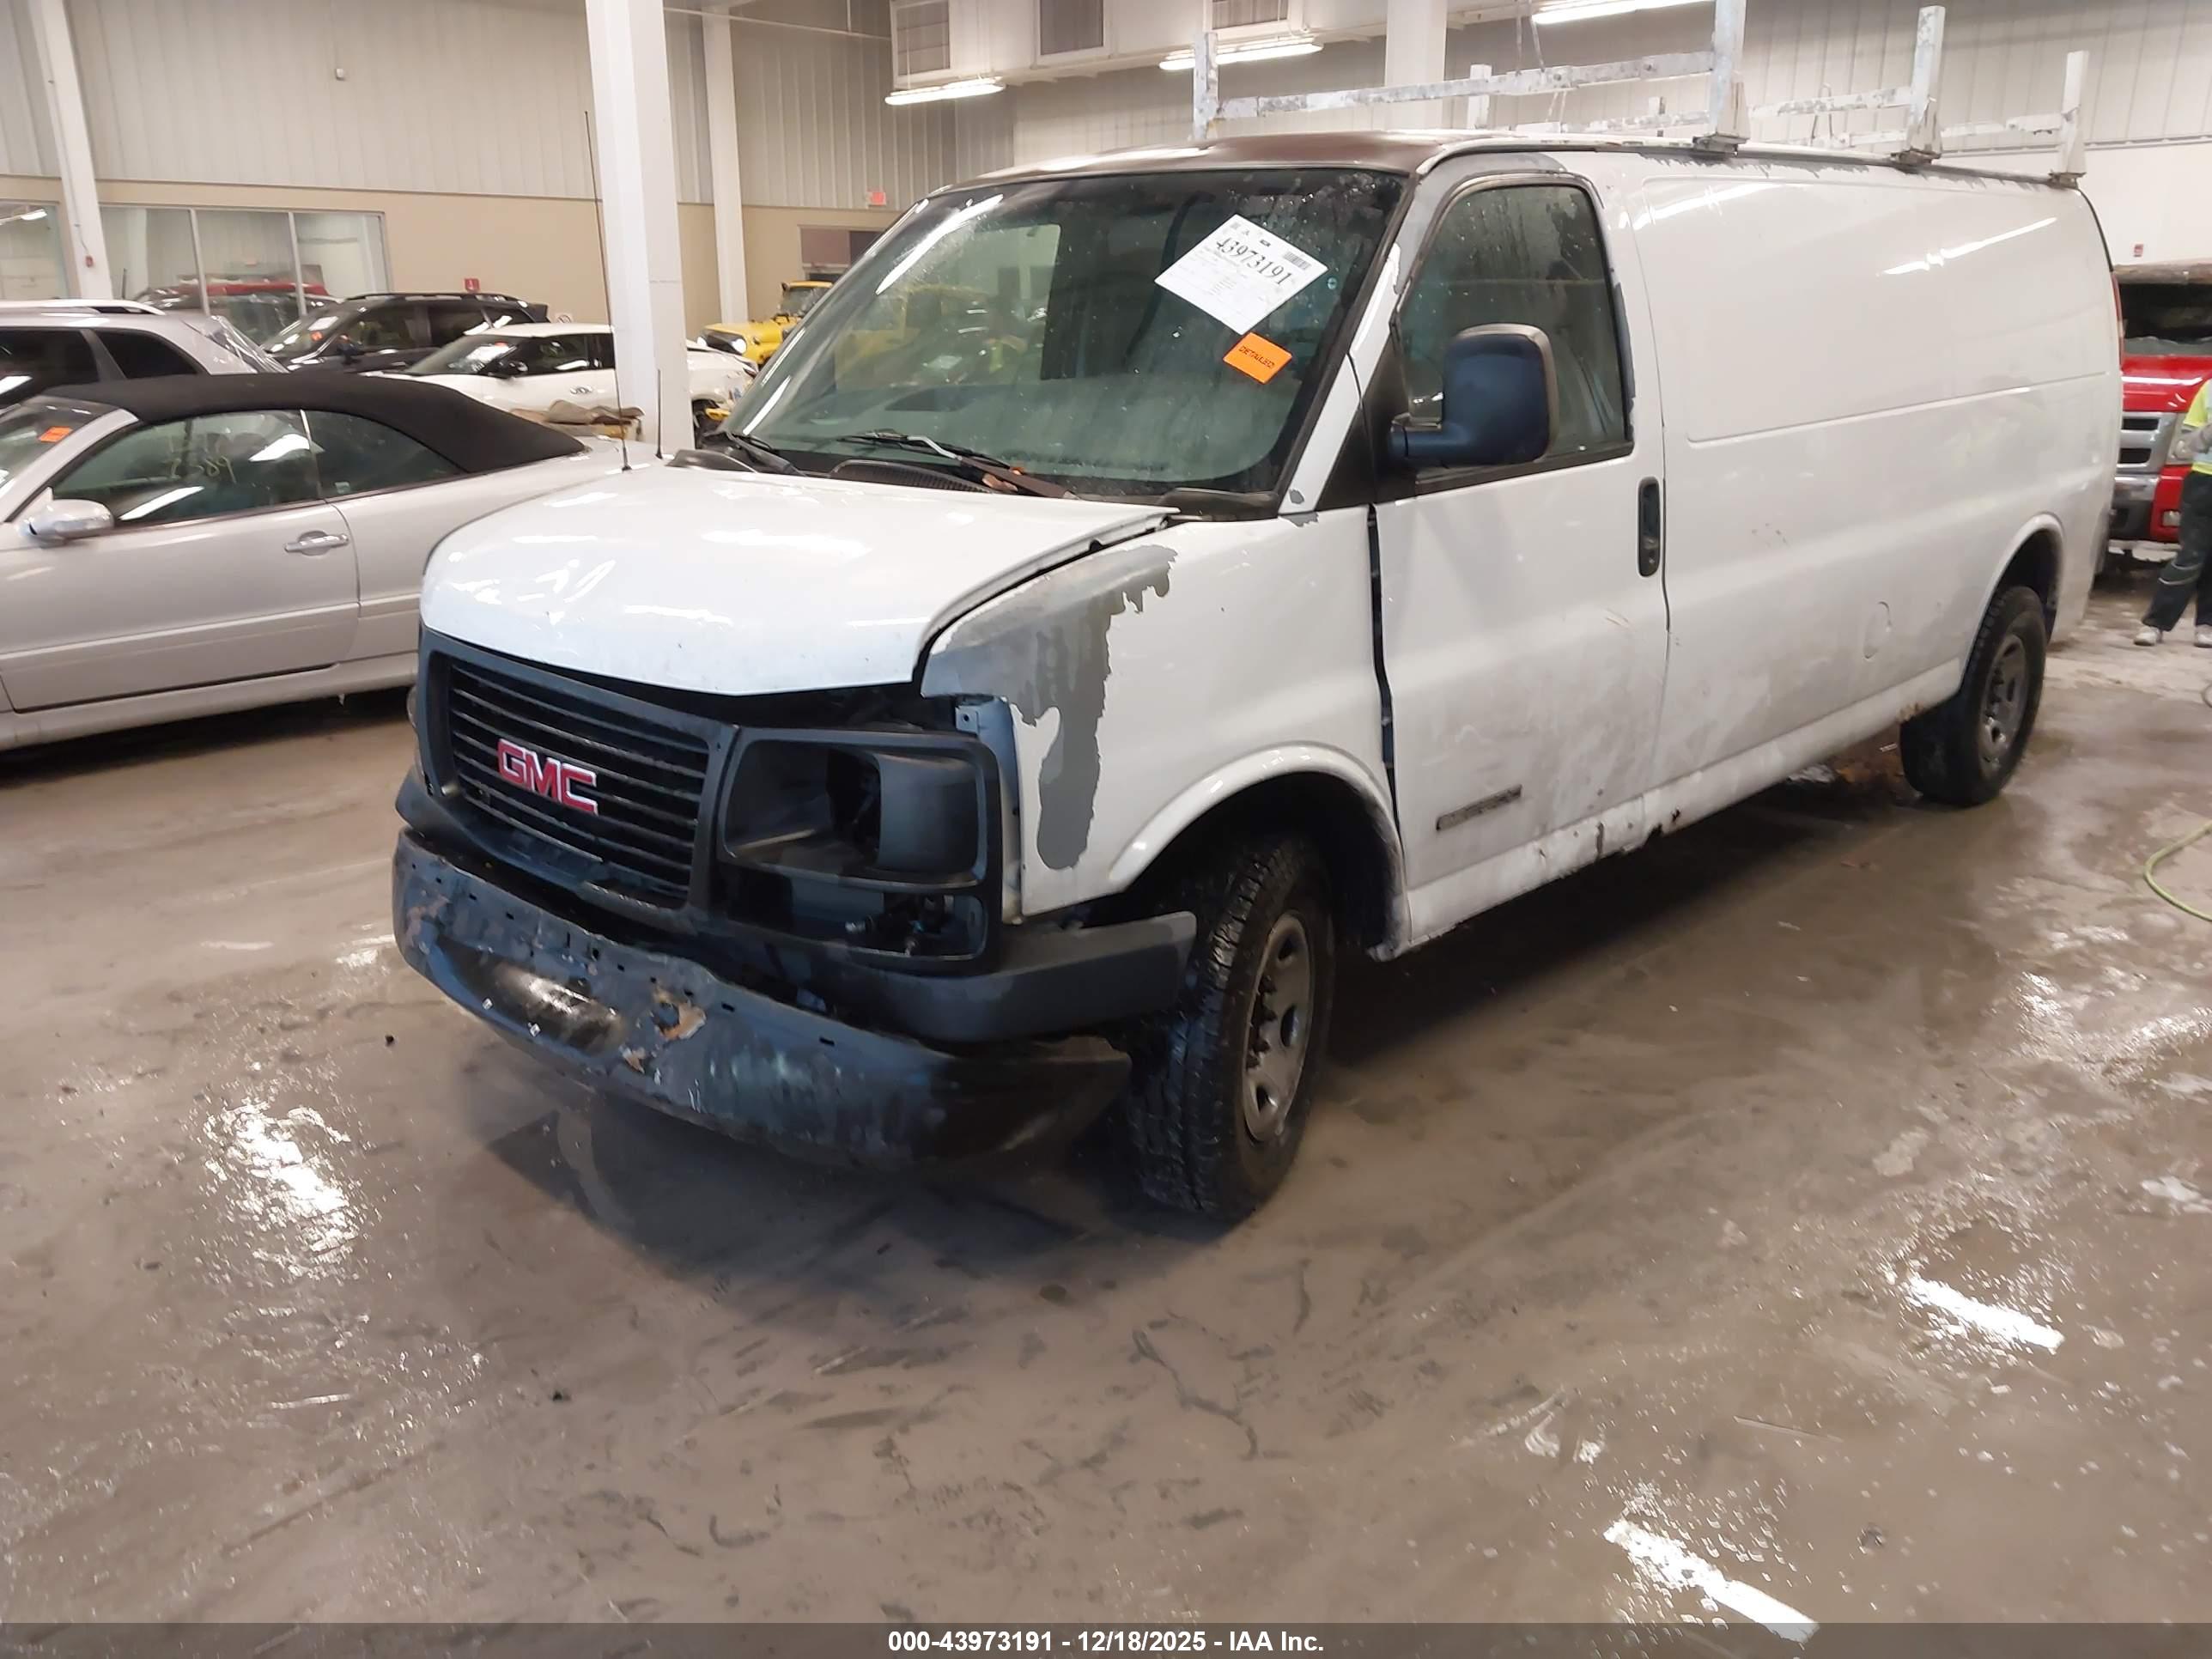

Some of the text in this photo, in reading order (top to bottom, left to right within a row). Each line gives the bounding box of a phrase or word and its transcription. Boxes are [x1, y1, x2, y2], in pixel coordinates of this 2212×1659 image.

[1216, 237, 1291, 285] 43973191
[1238, 345, 1275, 369] DETAILED
[498, 738, 599, 817] GMC
